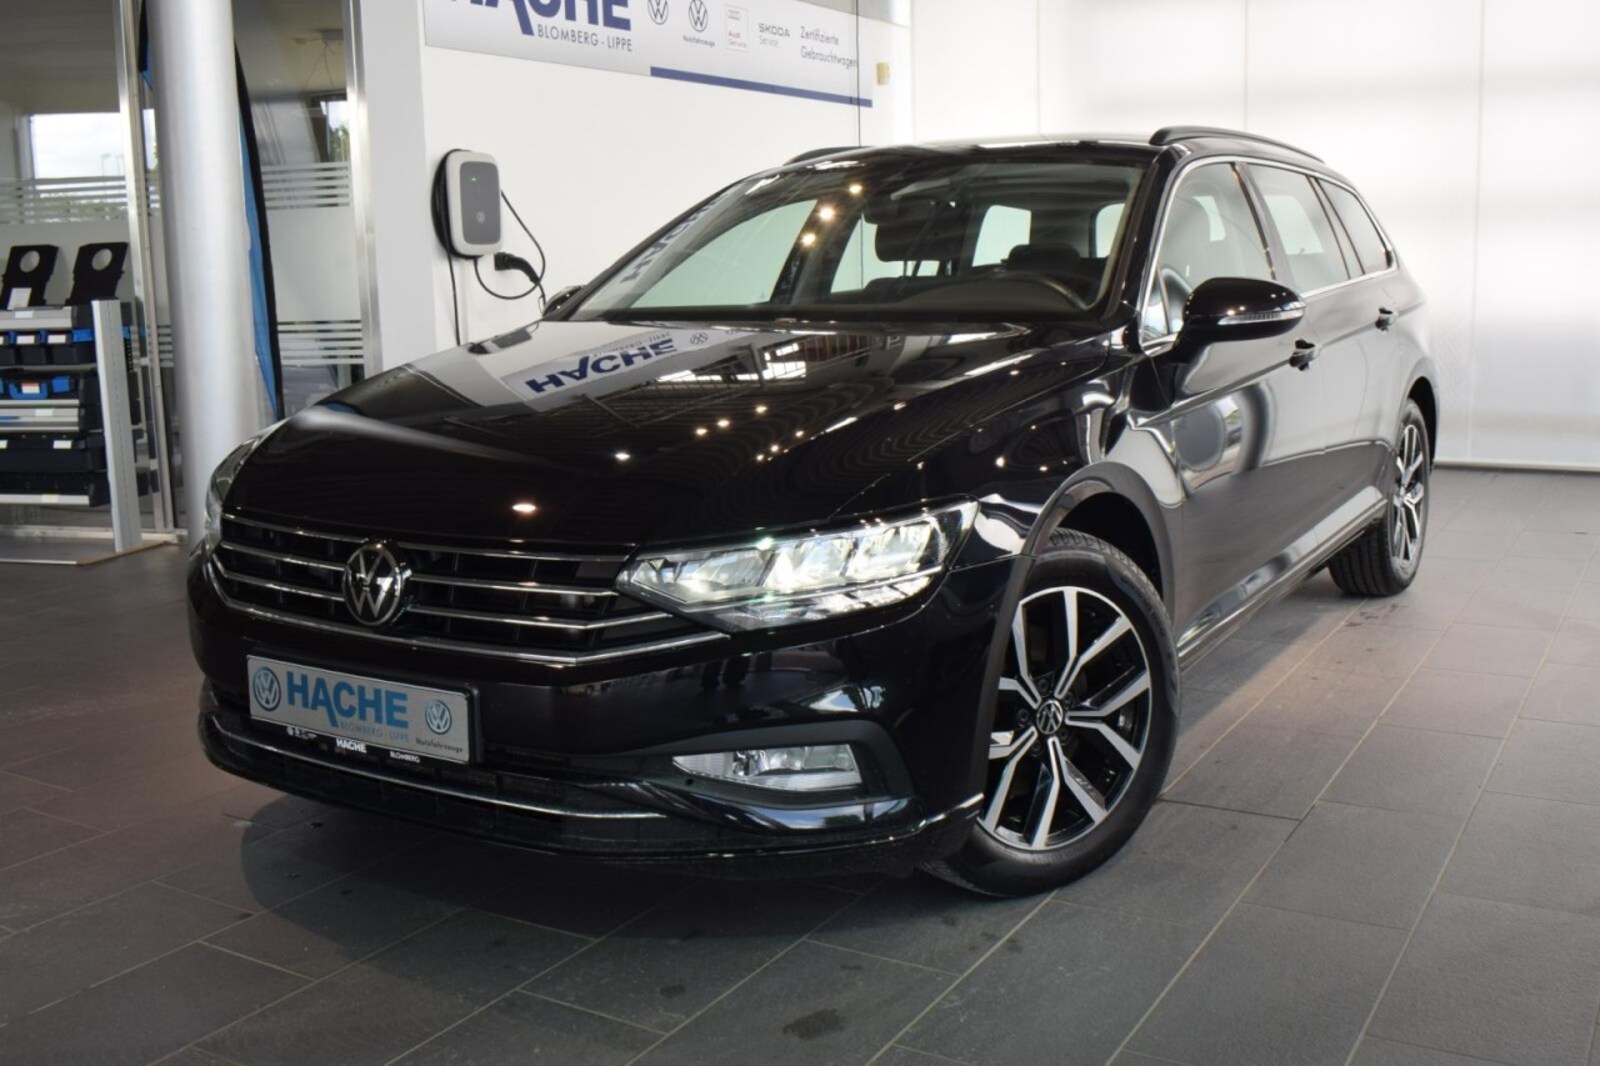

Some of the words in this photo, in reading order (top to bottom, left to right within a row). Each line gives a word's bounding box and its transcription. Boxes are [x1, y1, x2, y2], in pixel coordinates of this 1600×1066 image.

[538, 24, 599, 47] BLOMBERG
[607, 35, 633, 52] LIPPE
[286, 671, 409, 728] HACHE
[336, 737, 368, 753] HACHE
[389, 750, 420, 763] BLOMBERG
